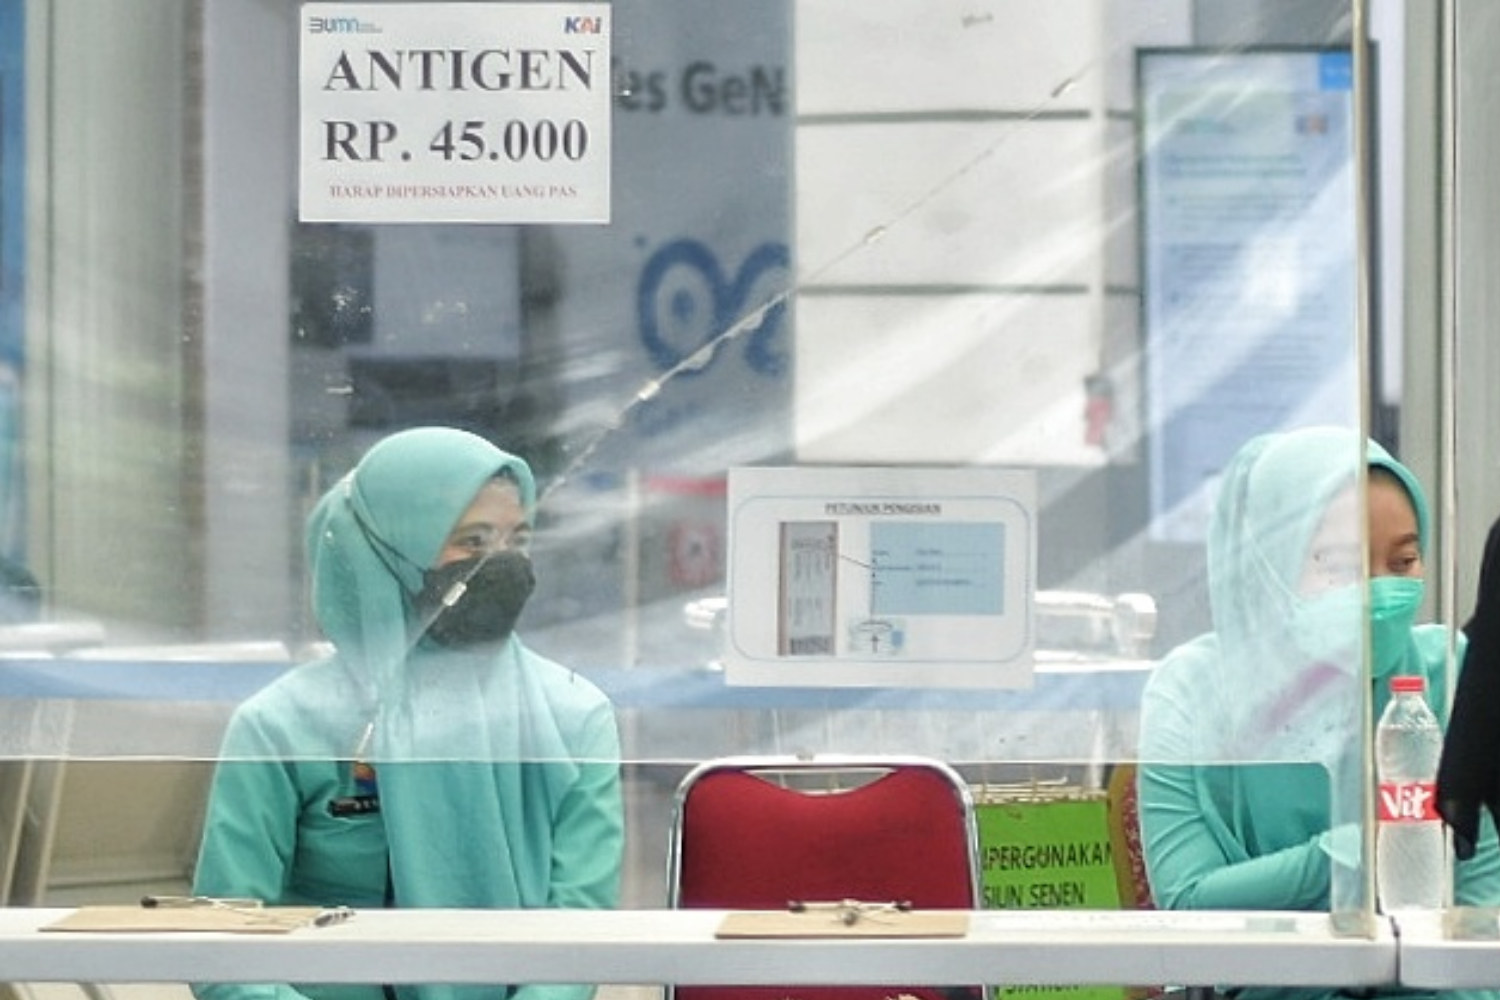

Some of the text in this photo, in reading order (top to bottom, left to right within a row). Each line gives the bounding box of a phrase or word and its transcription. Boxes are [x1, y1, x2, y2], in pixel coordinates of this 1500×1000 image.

[322, 49, 596, 92] ANTIGEN
[321, 119, 589, 162] RP. 45.000
[329, 184, 577, 198] HARAP DIPERSIAPKAN UANG PAS
[1029, 882, 1086, 907] SENEN
